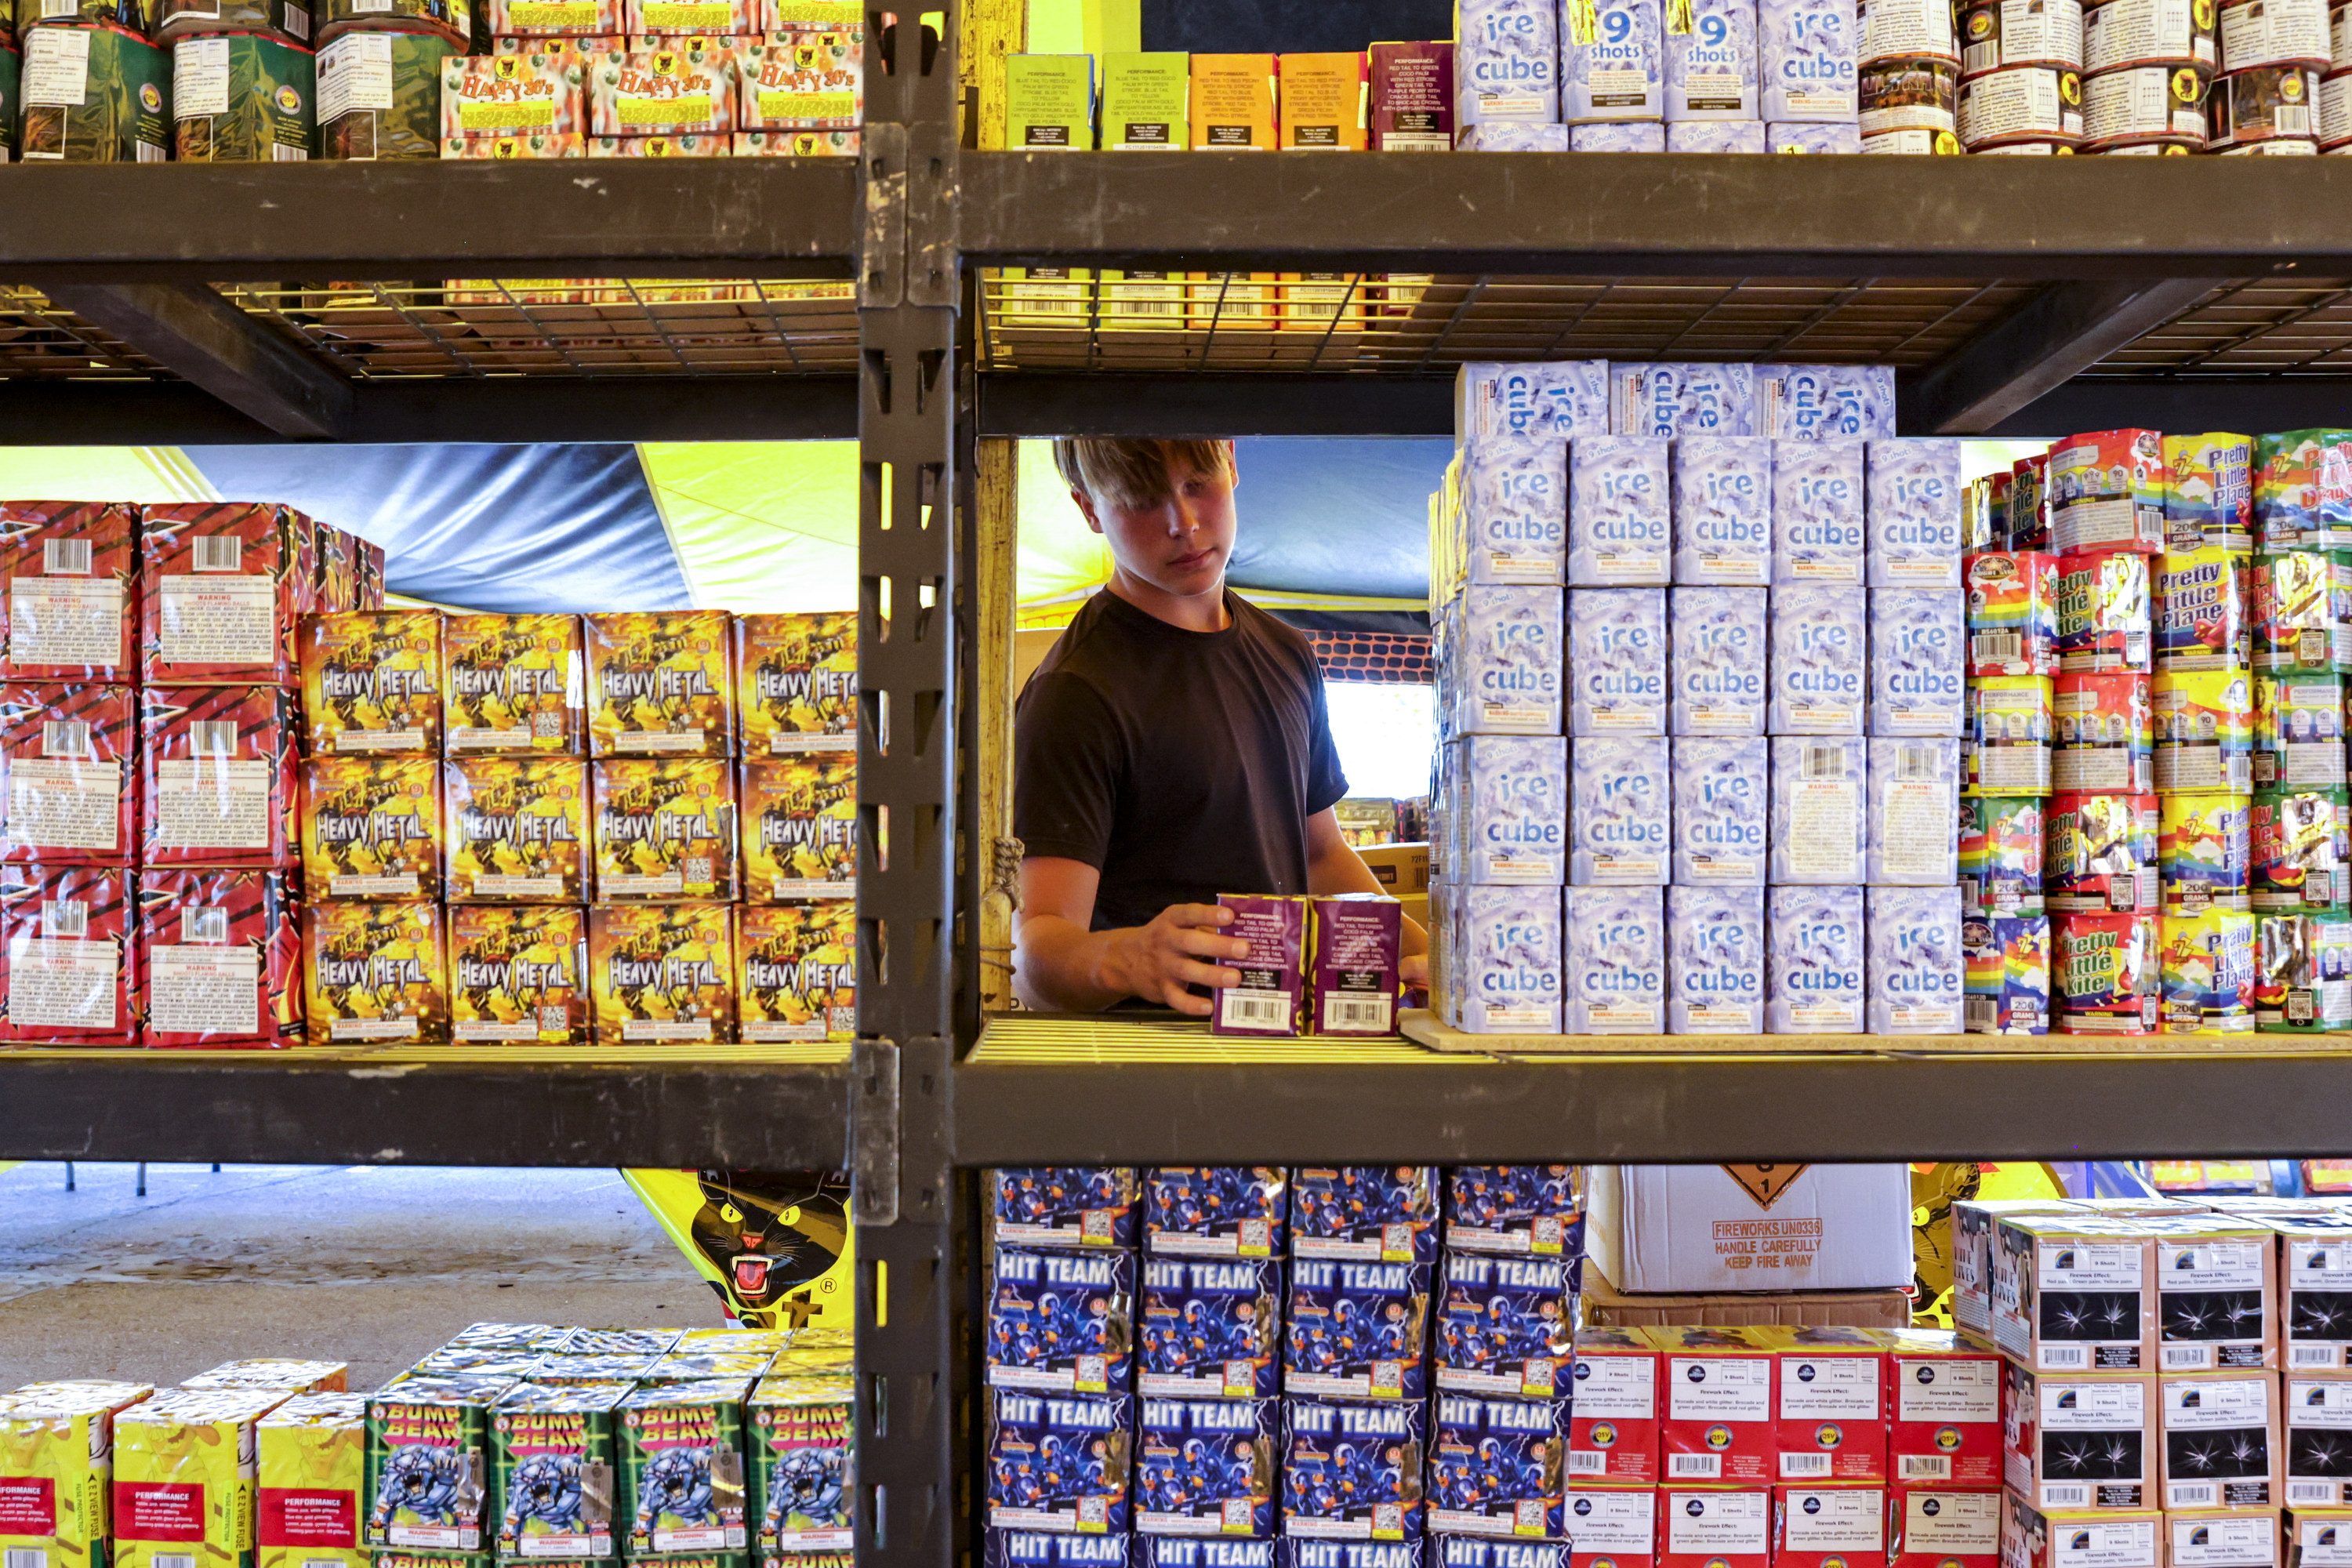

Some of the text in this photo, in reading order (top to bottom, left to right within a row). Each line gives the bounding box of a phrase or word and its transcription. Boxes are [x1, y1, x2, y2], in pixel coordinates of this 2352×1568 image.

[1486, 14, 1534, 42] ice
[1602, 11, 1631, 43] 9
[1699, 16, 1727, 47] 9
[1793, 12, 1841, 38] ice
[1591, 43, 1640, 59] shots
[1687, 46, 1736, 63] shots
[1475, 54, 1548, 80] cube
[1782, 53, 1853, 78] cube
[1548, 386, 1575, 433] ice
[1693, 382, 1720, 428] ice
[1835, 389, 1863, 434] ice
[2207, 444, 2249, 470] Pretty
[1501, 471, 1549, 499] ice
[1603, 471, 1651, 499] ice
[1706, 472, 1754, 500] ice
[1800, 477, 1848, 505] ice
[1895, 476, 1943, 503] ice
[2213, 467, 2248, 489] Little
[2211, 485, 2251, 510] Plane
[1489, 514, 1561, 540] cube
[1592, 514, 1665, 540] cube
[1696, 514, 1766, 541] cube
[1788, 518, 1860, 545] cube
[1883, 517, 1955, 545] cube
[2160, 561, 2222, 593] Pretty
[2164, 584, 2217, 612] Little
[2161, 602, 2223, 632] Plane
[1496, 622, 1544, 649] ice
[1601, 626, 1649, 653] ice
[1800, 623, 1847, 651] ice
[1900, 625, 1947, 653] ice
[321, 661, 437, 710] HEAVY METAL
[449, 661, 567, 709] HEAVY METAL
[600, 661, 719, 711] HEAVY METAL
[1483, 664, 1556, 691] cube
[1588, 668, 1661, 694] cube
[1787, 665, 1858, 691] cube
[1888, 666, 1959, 694] cube
[1500, 774, 1548, 802] ice
[1602, 774, 1650, 802] ice
[314, 812, 371, 855] HEAVY
[372, 805, 432, 852] METAL
[1487, 815, 1560, 843] cube
[1590, 815, 1664, 843] cube
[1494, 924, 1543, 950] ice
[1597, 924, 1646, 950] ice
[1800, 923, 1846, 951] ice
[1898, 924, 1946, 952] ice
[2062, 931, 2118, 955] Pretty
[2207, 924, 2252, 953] Pretty
[2063, 952, 2113, 978] Little
[2214, 946, 2250, 972] Little
[315, 949, 432, 999] HEAVY METAL
[457, 953, 575, 1000] HEAVY METAL
[608, 951, 726, 999] HEAVY METAL
[746, 957, 801, 1000] HEAVY
[1483, 964, 1556, 991] cube
[1584, 964, 1659, 991] cube
[1787, 964, 1859, 990] cube
[1886, 965, 1958, 992] cube
[2067, 974, 2106, 997] Kite
[2211, 964, 2255, 993] Plane
[2015, 1001, 2034, 1010] 200
[1760, 1178, 1769, 1194] 1
[1715, 1220, 1820, 1237] FIREWORKS UN0336
[1715, 1239, 1822, 1254] HANDLE CAREFULLY
[1000, 1254, 1111, 1286] HIT TEAM
[1294, 1260, 1408, 1290] HIT TEAM
[1450, 1258, 1563, 1287] HIT TEAM
[1726, 1254, 1813, 1269] KEEP FIRE AWAY
[1145, 1263, 1256, 1290] HIT TEAM
[387, 1403, 461, 1424] BUMP
[510, 1414, 586, 1432] BUMP
[641, 1406, 717, 1425] BUMP
[772, 1406, 848, 1425] BUMP
[1000, 1398, 1112, 1428] HIT TEAM
[1143, 1401, 1255, 1429] HIT TEAM
[1294, 1406, 1408, 1435] HIT TEAM
[1440, 1399, 1552, 1430] HIT TEAM
[384, 1421, 462, 1441] BEAR
[509, 1430, 588, 1451] BEAR
[640, 1424, 720, 1445] BEAR
[770, 1423, 851, 1444] BEAR
[135, 1492, 190, 1501] PERFORMANCE
[285, 1498, 341, 1507] PERFORMANCE
[236, 1529, 246, 1549] FUSE
